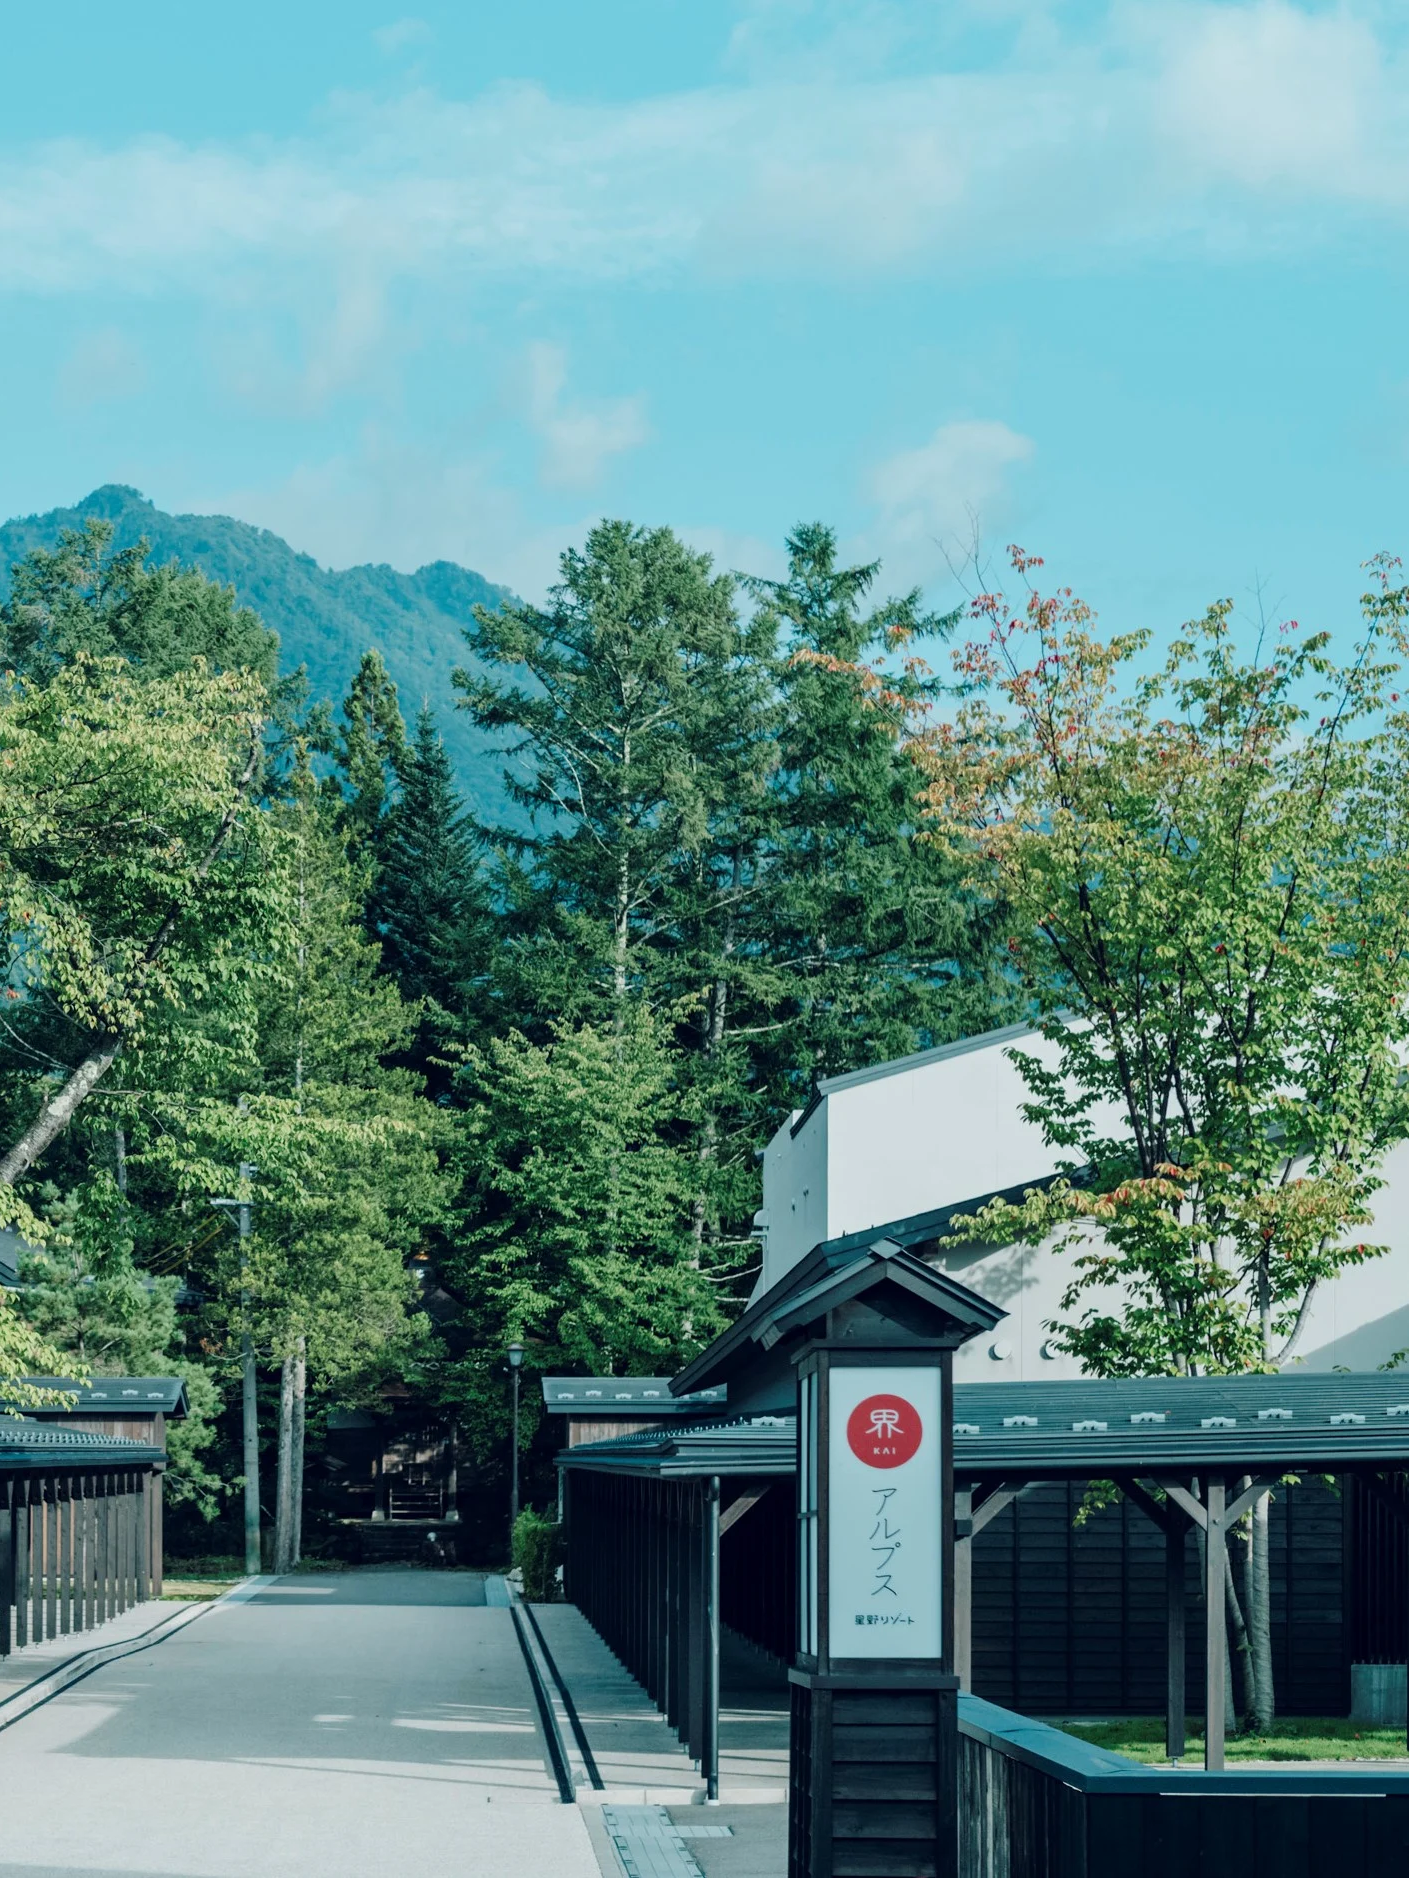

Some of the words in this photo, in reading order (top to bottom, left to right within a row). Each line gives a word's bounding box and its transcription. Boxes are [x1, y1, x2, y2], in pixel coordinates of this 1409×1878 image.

[865, 1408, 904, 1439] 界
[873, 1446, 896, 1455] KAI
[869, 1487, 901, 1596] アルプス
[854, 1612, 915, 1626] 星野リゾート
